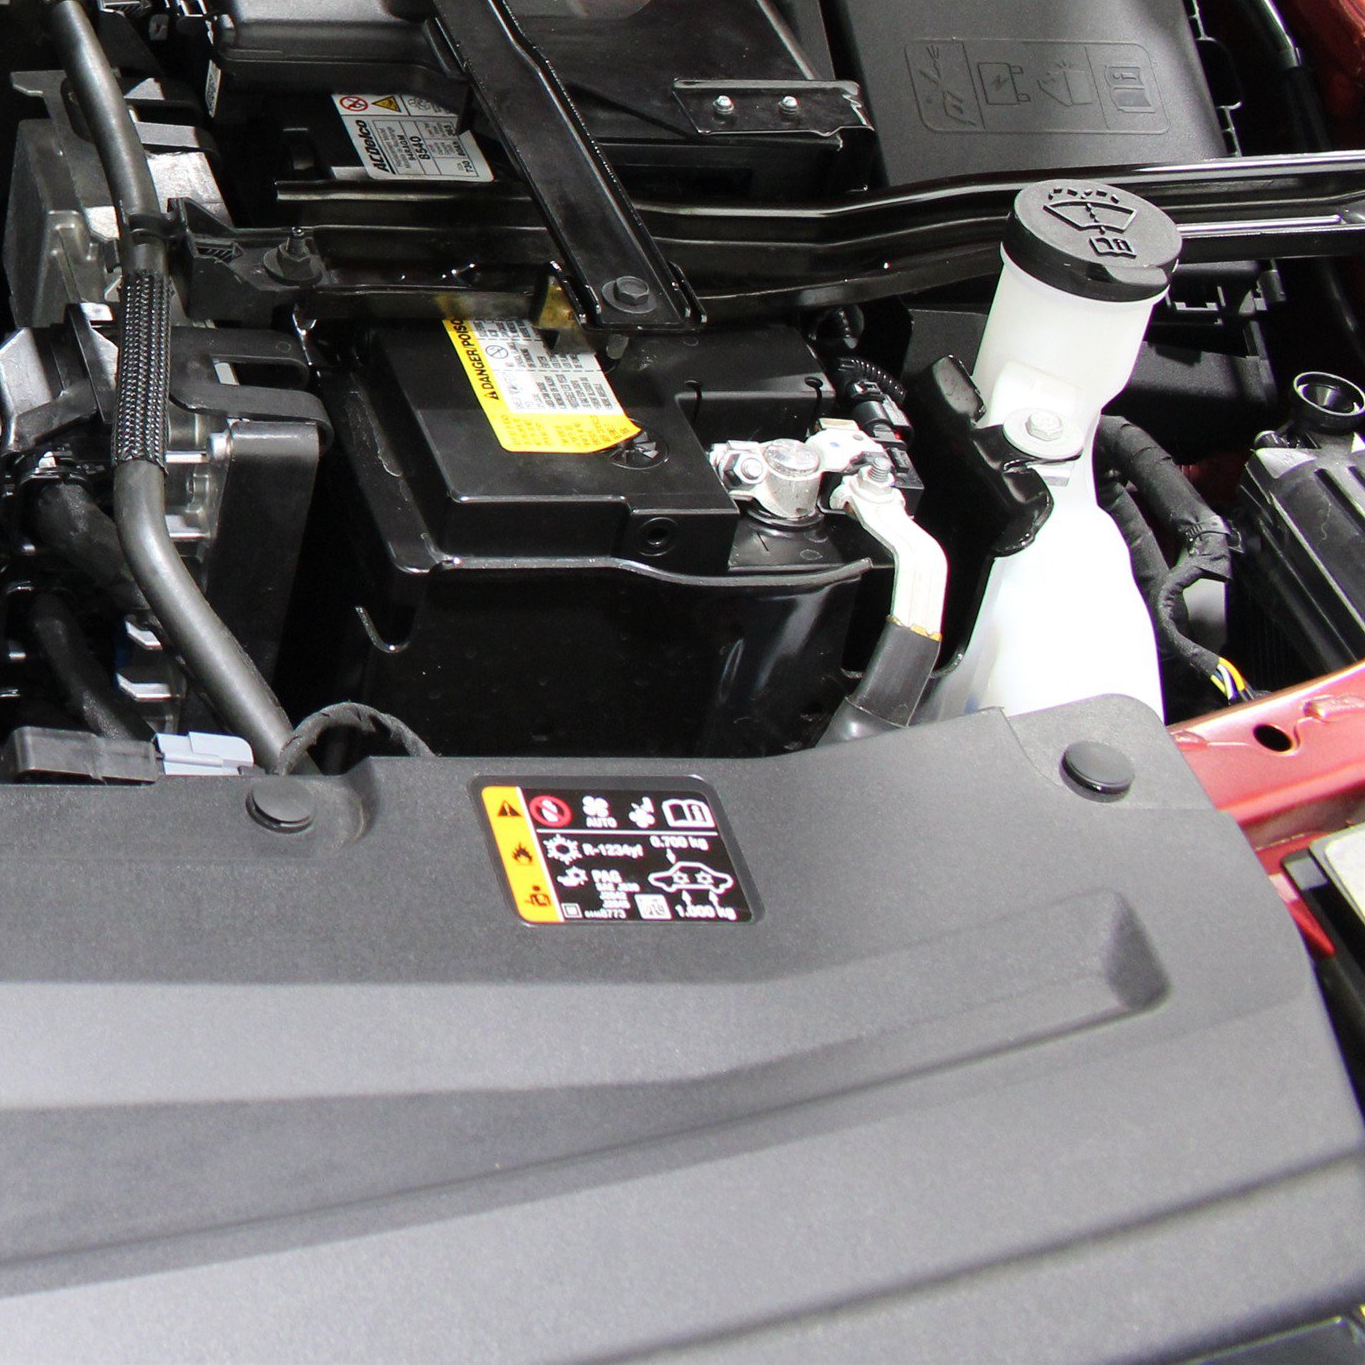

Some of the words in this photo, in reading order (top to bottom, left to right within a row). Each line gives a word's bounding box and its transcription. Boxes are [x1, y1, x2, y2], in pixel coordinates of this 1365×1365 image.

[355, 119, 389, 173] ACDelco
[410, 136, 430, 160] 8540
[462, 160, 474, 173] 730
[450, 318, 495, 390] DANGER/POISO
[586, 816, 618, 828] AUTO
[582, 842, 644, 859] R-1234yf
[688, 836, 709, 851] kg
[717, 905, 737, 921] kg
